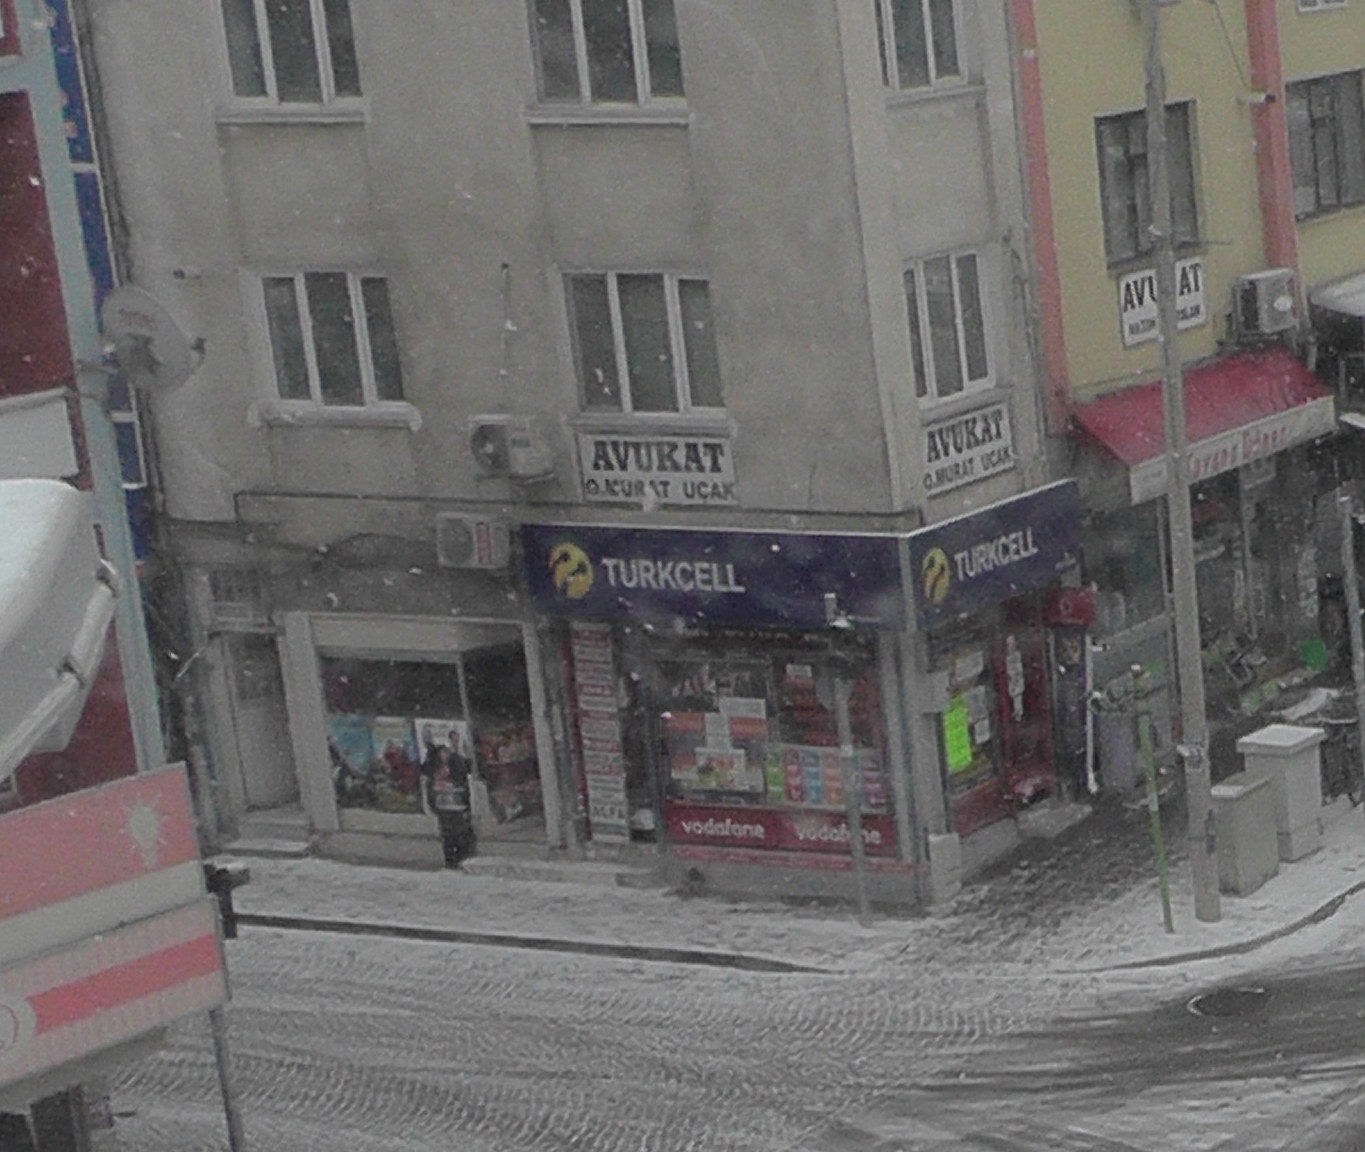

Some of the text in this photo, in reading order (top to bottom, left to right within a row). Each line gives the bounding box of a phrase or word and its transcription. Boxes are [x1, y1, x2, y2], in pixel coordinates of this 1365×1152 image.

[926, 409, 1004, 464] AVUKAT
[592, 440, 724, 474] AVUKAT
[953, 526, 1039, 582] TURKCELL
[602, 557, 746, 593] TURKCELL
[681, 817, 766, 839] vodafone
